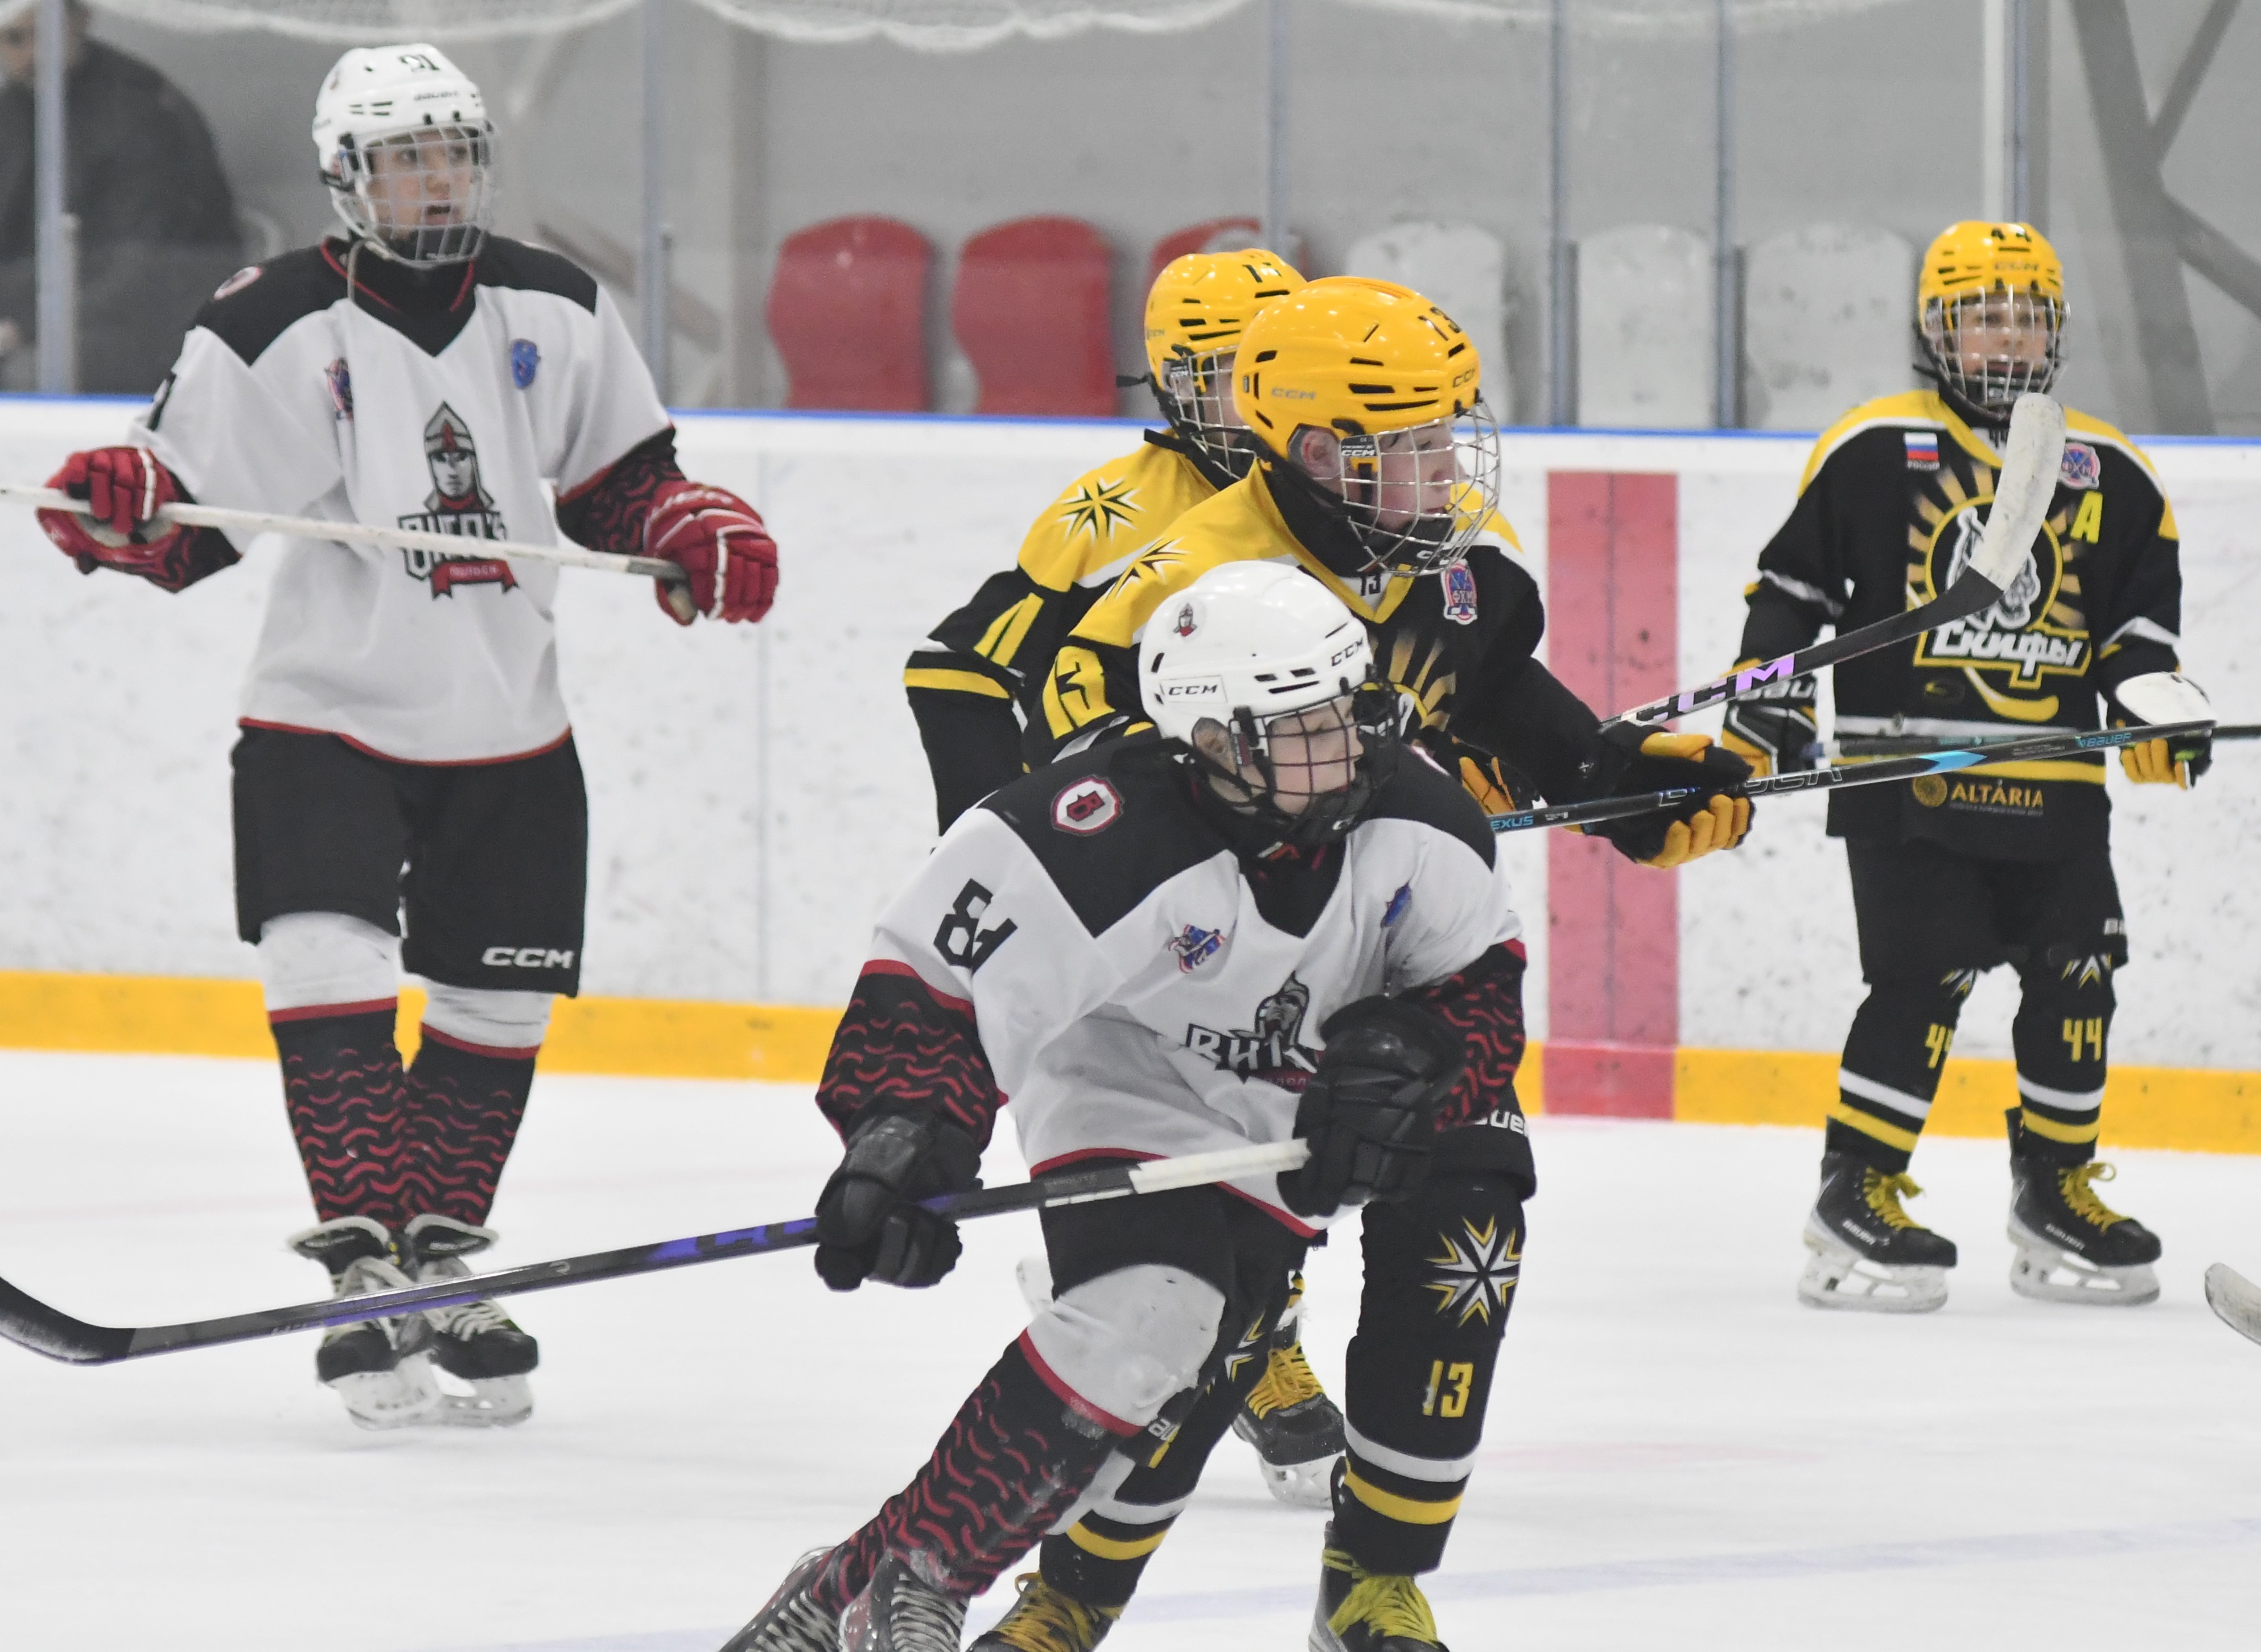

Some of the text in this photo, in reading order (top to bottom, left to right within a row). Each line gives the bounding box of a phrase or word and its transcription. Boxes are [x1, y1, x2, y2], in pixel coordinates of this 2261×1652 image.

[1271, 387, 1317, 399] CCM
[2070, 491, 2103, 545] A
[1361, 572, 1381, 596] 13
[1331, 637, 1365, 667] CCM
[1168, 683, 1219, 696] CCM
[1489, 814, 1534, 831] EXUS
[481, 946, 575, 969] CCM
[2062, 1016, 2102, 1062] 44
[1422, 1359, 1474, 1418] 13
